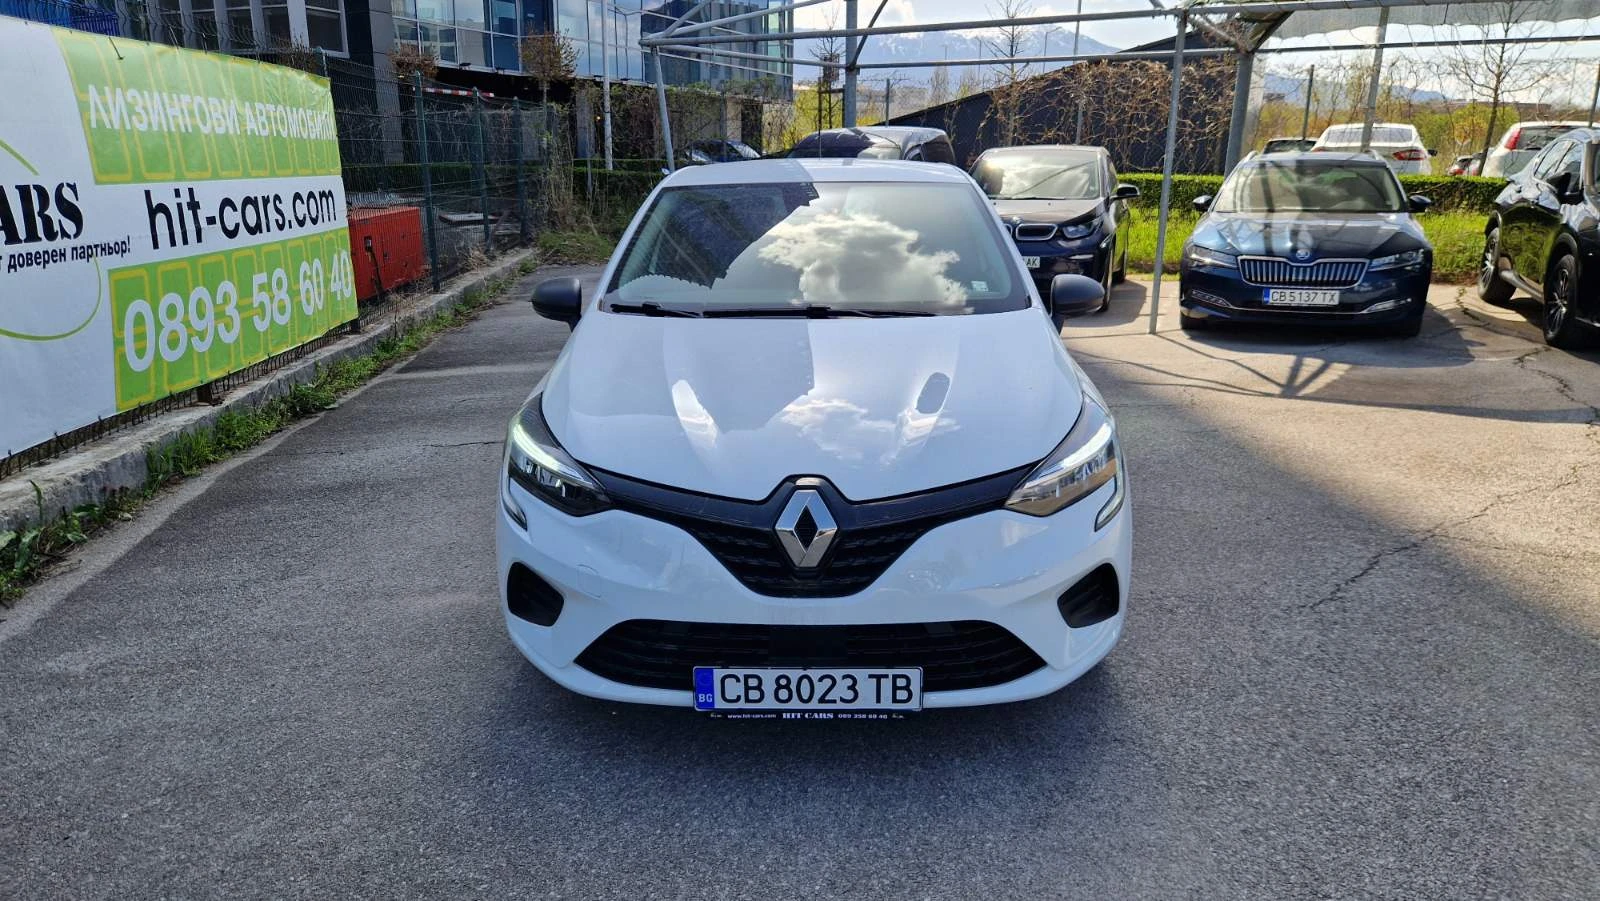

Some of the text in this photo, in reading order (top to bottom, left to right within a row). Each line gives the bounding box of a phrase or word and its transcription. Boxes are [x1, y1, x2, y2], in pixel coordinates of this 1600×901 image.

[88, 83, 338, 141] ЛИЗИНГОВИ АВТОМОБИЛИ
[144, 187, 337, 250] hit-cars.com
[7, 247, 67, 274] доверен
[71, 235, 131, 263] партньор!
[124, 250, 352, 373] 0893 58 60 40
[1271, 290, 1287, 302] CB
[1288, 291, 1319, 303] 5137
[1320, 291, 1337, 304] TX
[698, 693, 713, 703] BG
[720, 673, 914, 704] CB 8023 TB
